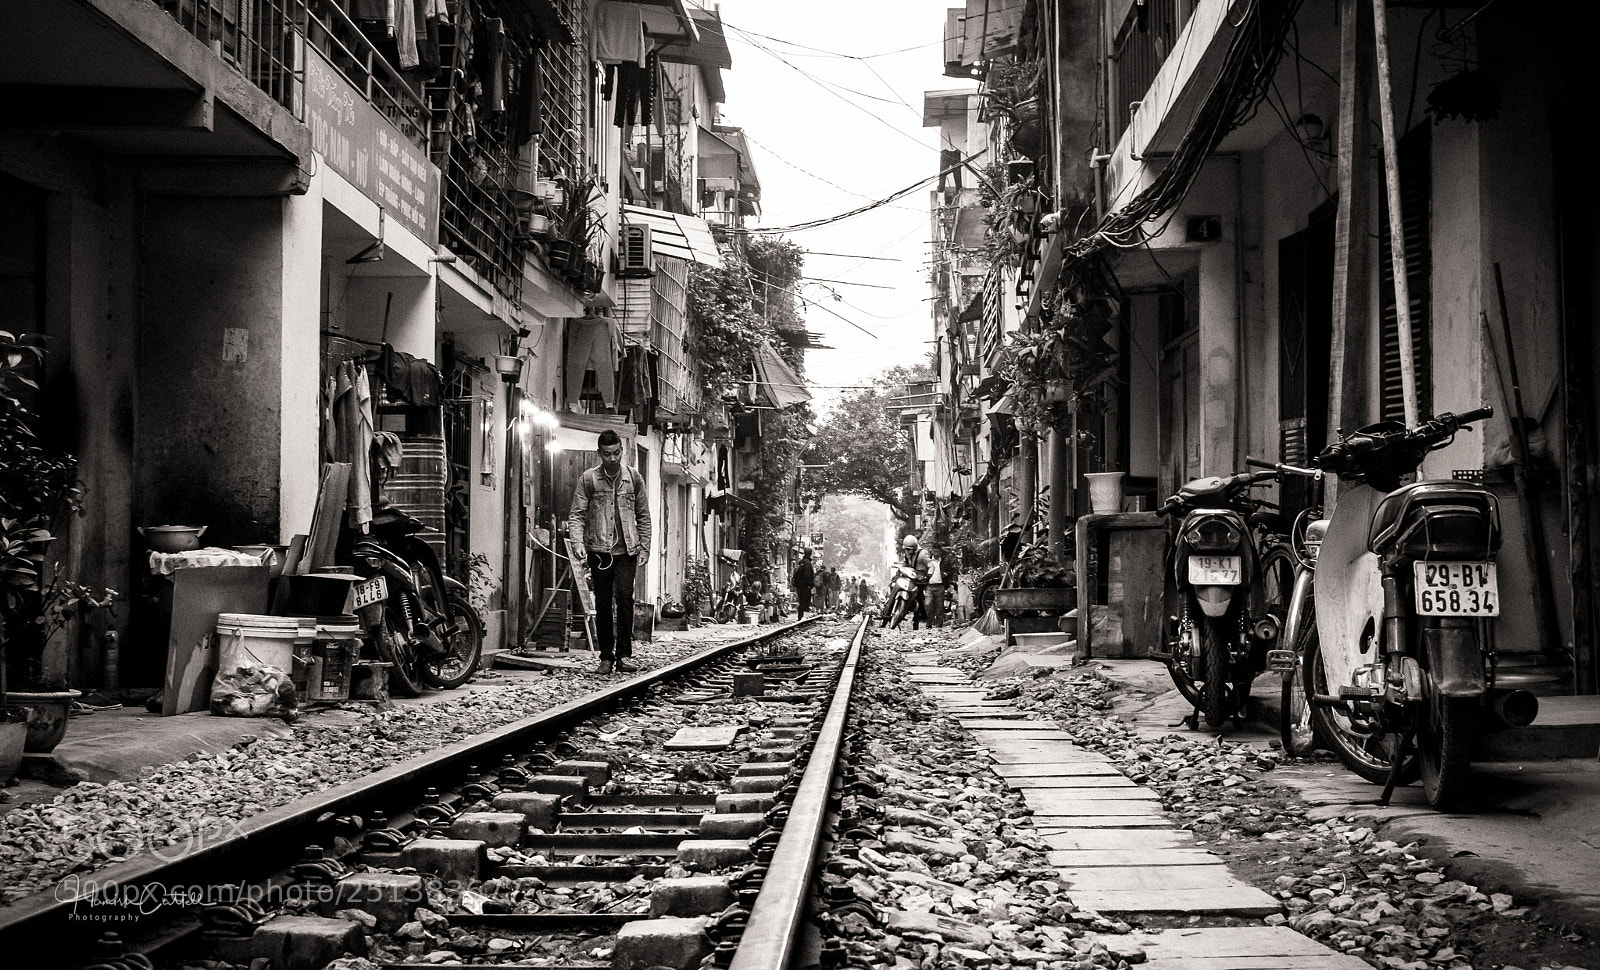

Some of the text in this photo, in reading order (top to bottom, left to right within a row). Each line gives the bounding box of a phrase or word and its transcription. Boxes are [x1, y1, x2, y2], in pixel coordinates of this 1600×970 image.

[1198, 220, 1209, 238] 4
[1198, 557, 1232, 569] 19-K1
[1426, 564, 1486, 588] 29-B1
[1421, 590, 1494, 613] 658.34
